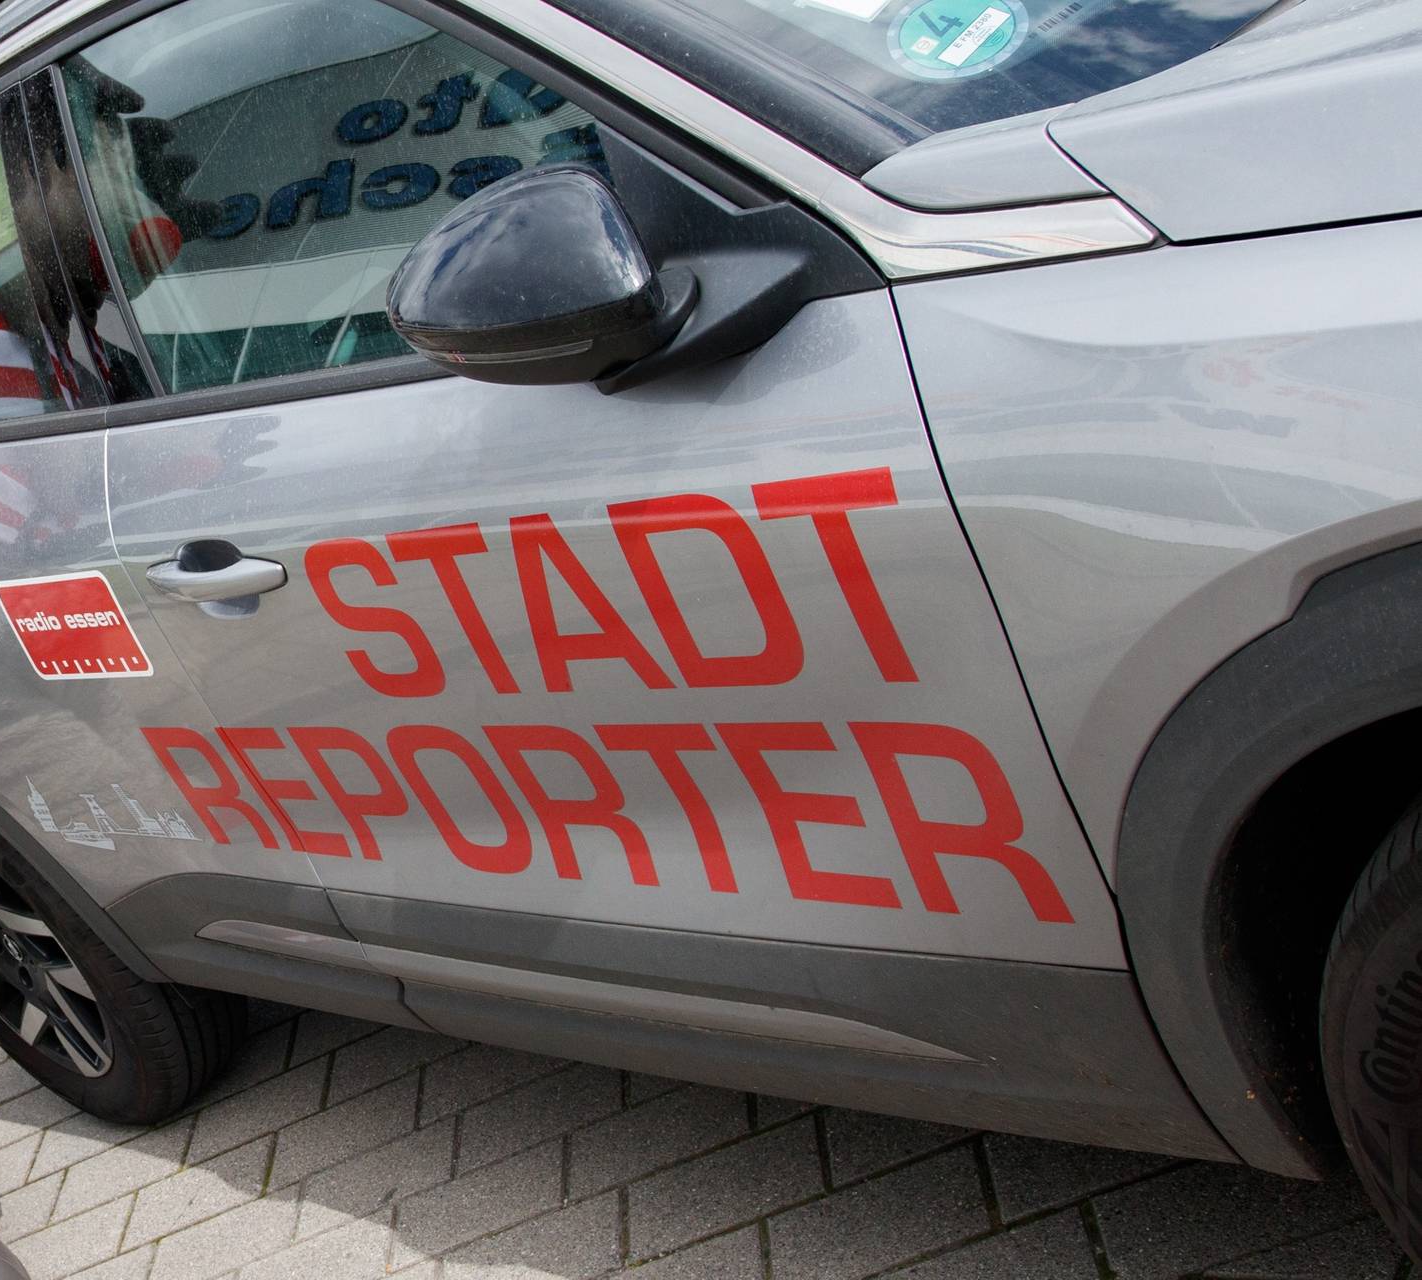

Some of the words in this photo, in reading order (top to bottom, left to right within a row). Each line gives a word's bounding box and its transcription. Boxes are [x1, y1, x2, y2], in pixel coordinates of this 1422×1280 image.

[918, 11, 964, 38] 4
[16, 612, 61, 633] radio
[65, 610, 120, 629] essen
[304, 467, 919, 698] STADT
[142, 722, 1074, 925] REPORTER
[1359, 948, 1422, 1104] Contin
